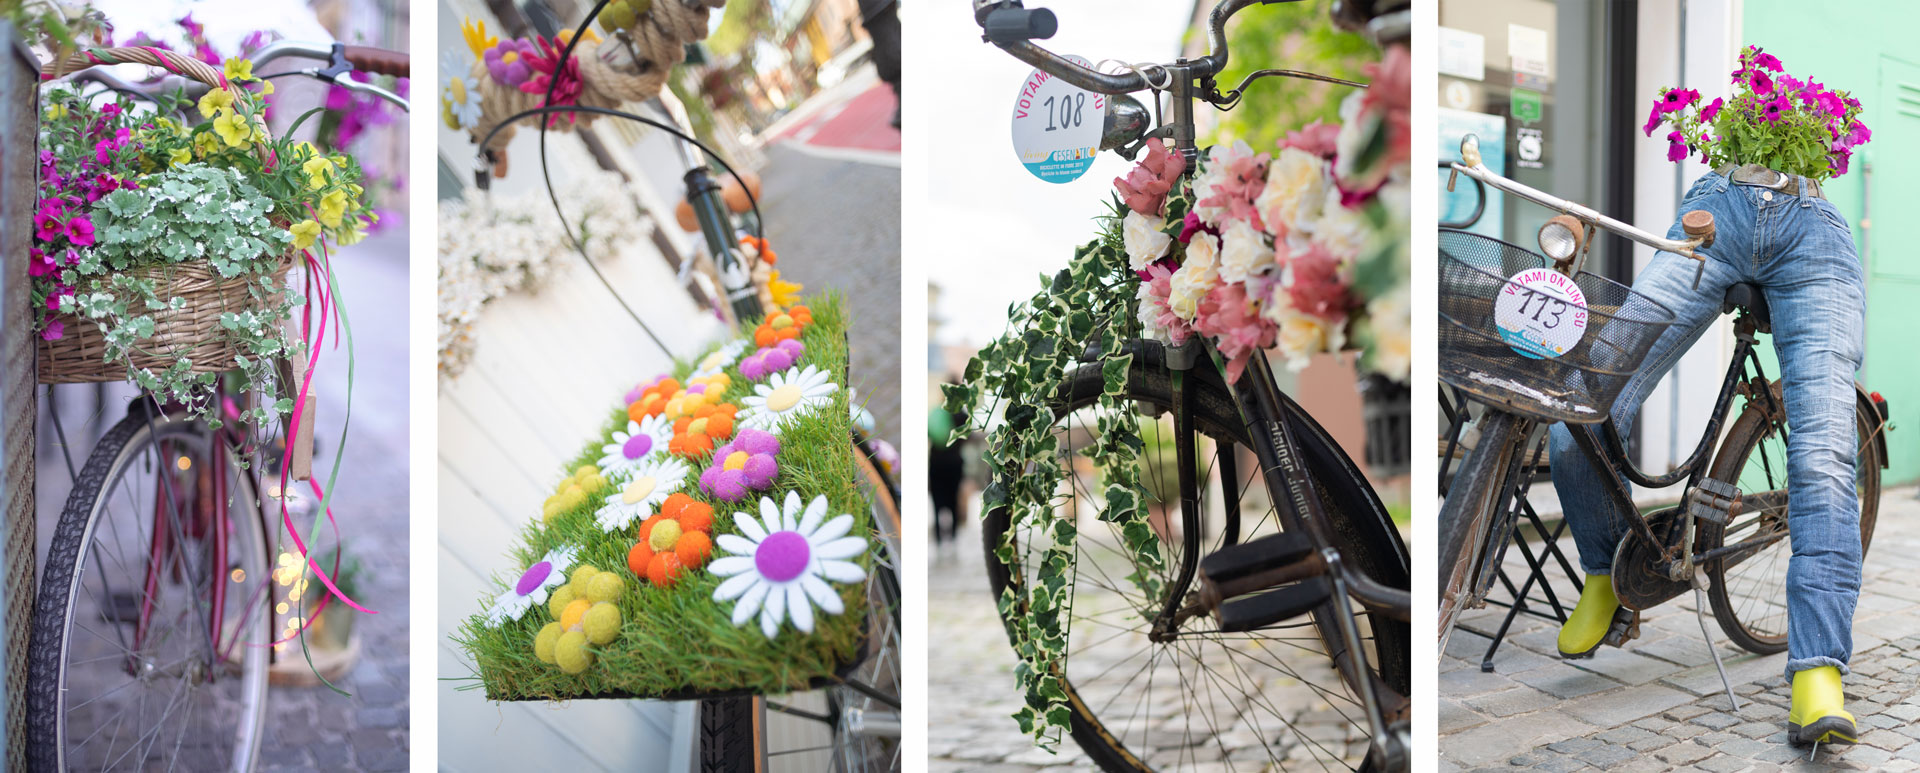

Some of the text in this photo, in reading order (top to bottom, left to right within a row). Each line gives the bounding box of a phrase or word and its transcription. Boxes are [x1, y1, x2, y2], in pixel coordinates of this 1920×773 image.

[1016, 69, 1053, 119] VOTAM
[1043, 92, 1085, 132] 108
[1518, 290, 1567, 329] 113
[1549, 273, 1567, 288] ON
[1574, 312, 1586, 328] SU
